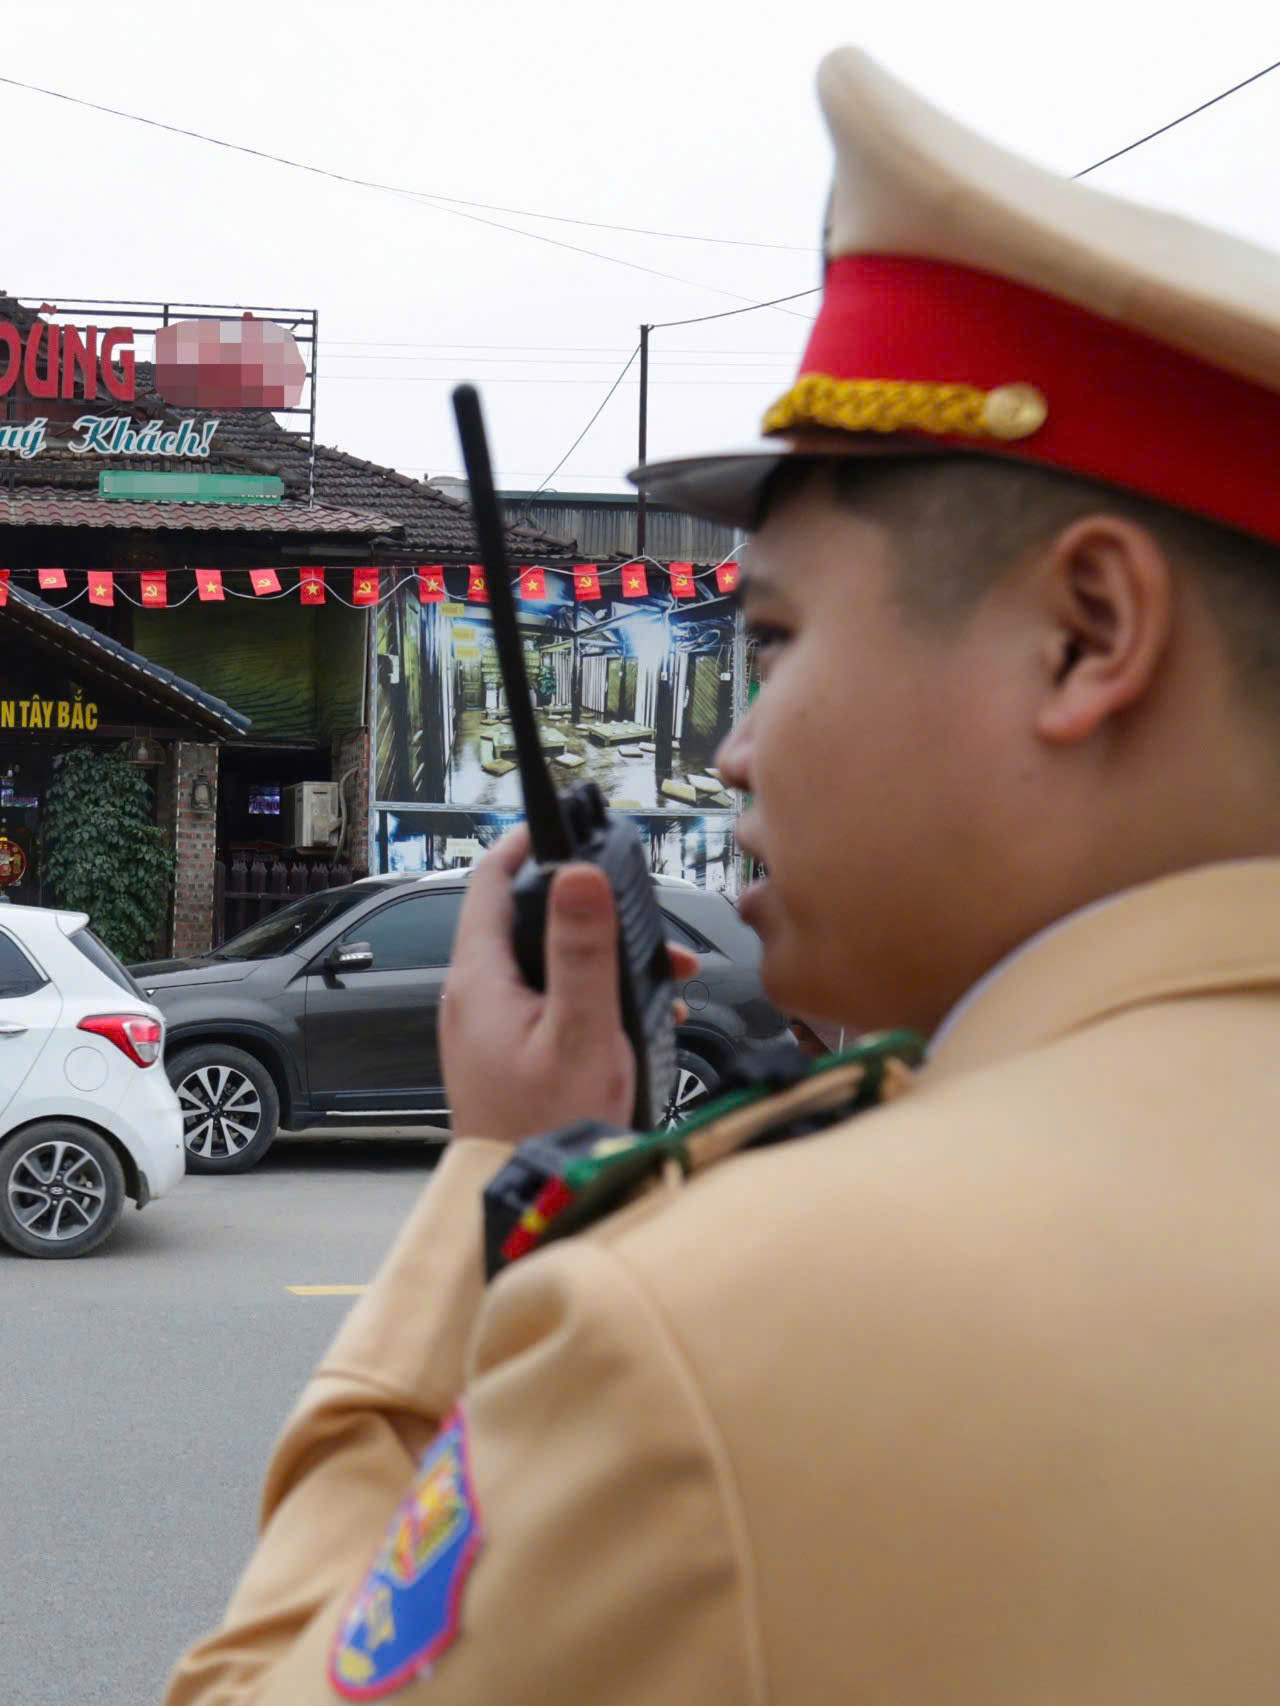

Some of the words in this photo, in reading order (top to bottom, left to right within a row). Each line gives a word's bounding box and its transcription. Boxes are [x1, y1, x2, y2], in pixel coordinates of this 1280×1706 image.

[67, 415, 219, 457] Khách!
[19, 694, 54, 728] TÂY
[58, 689, 98, 731] BẮC
